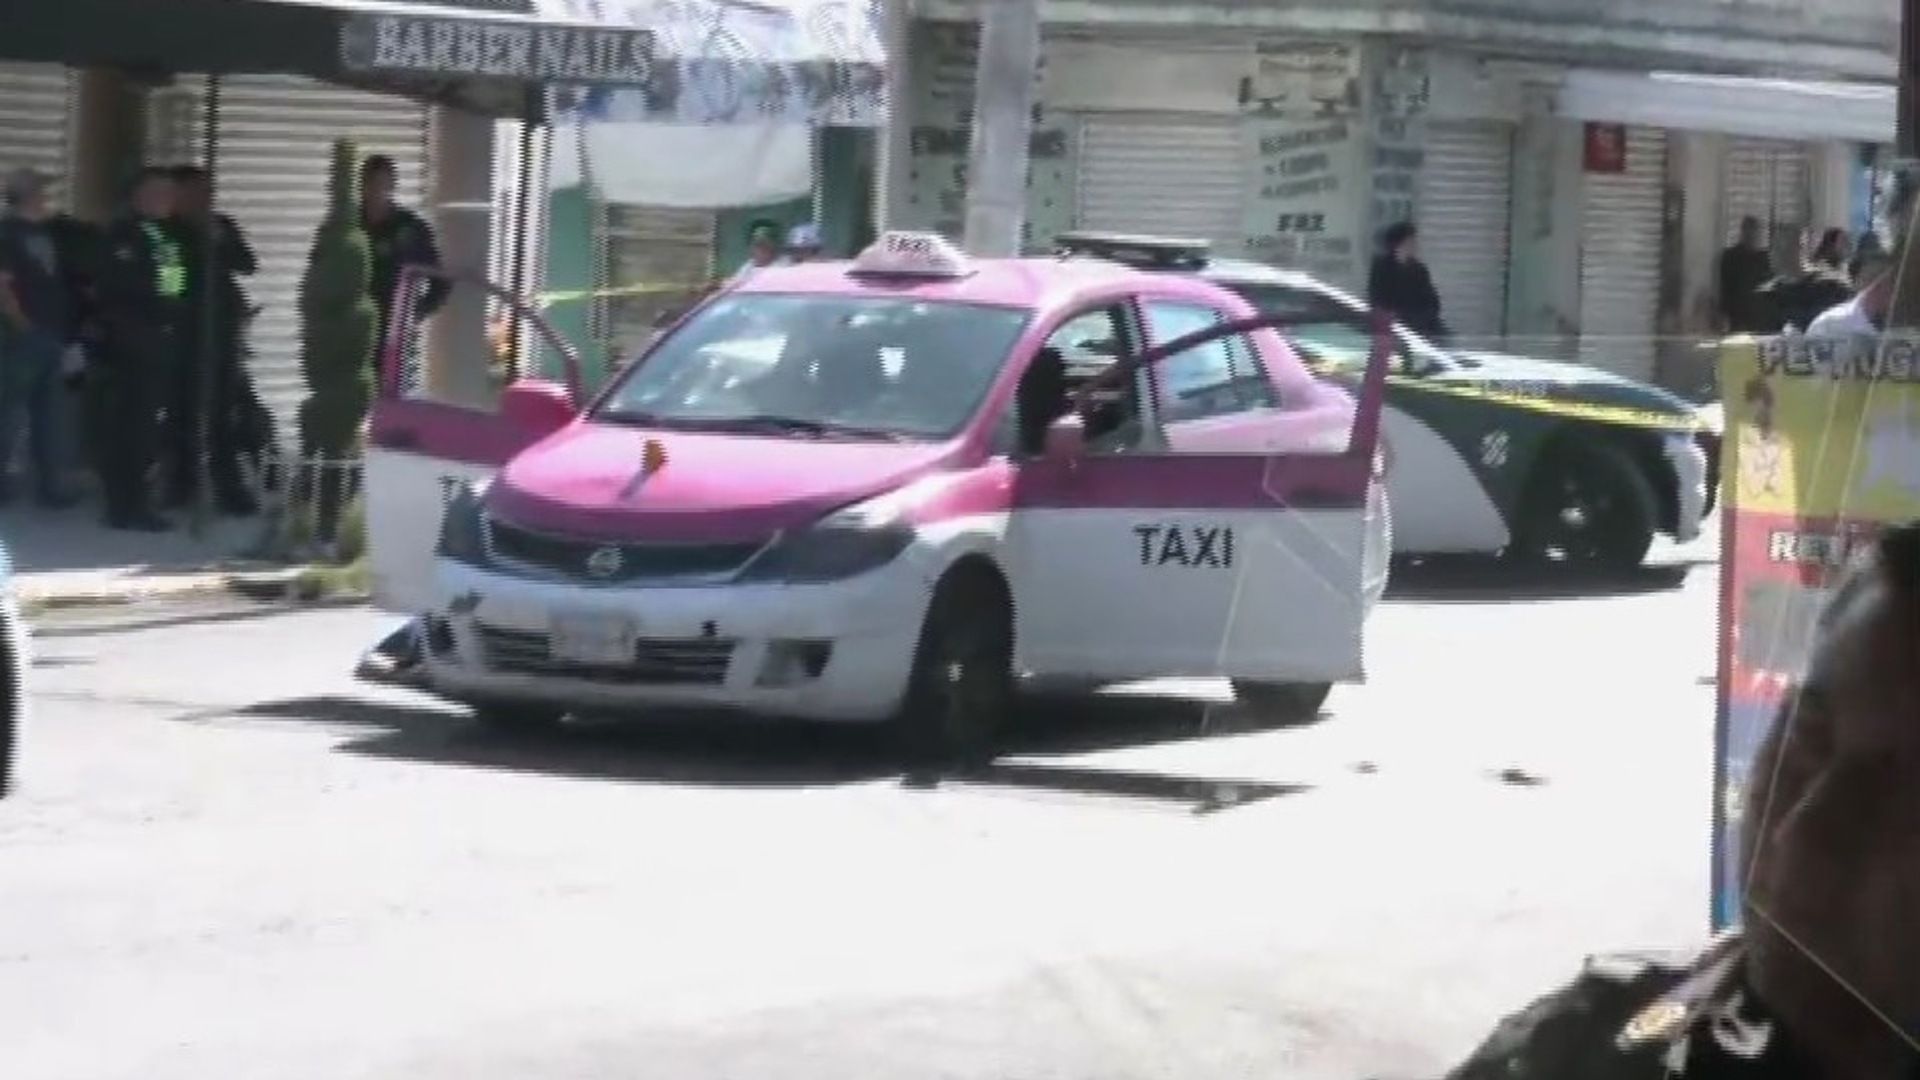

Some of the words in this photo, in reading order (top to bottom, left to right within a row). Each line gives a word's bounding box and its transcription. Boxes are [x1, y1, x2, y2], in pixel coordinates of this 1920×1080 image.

[373, 17, 532, 76] BARBER
[535, 28, 653, 83] NAILS
[887, 234, 931, 253] TAXI
[1132, 524, 1235, 568] TAXI
